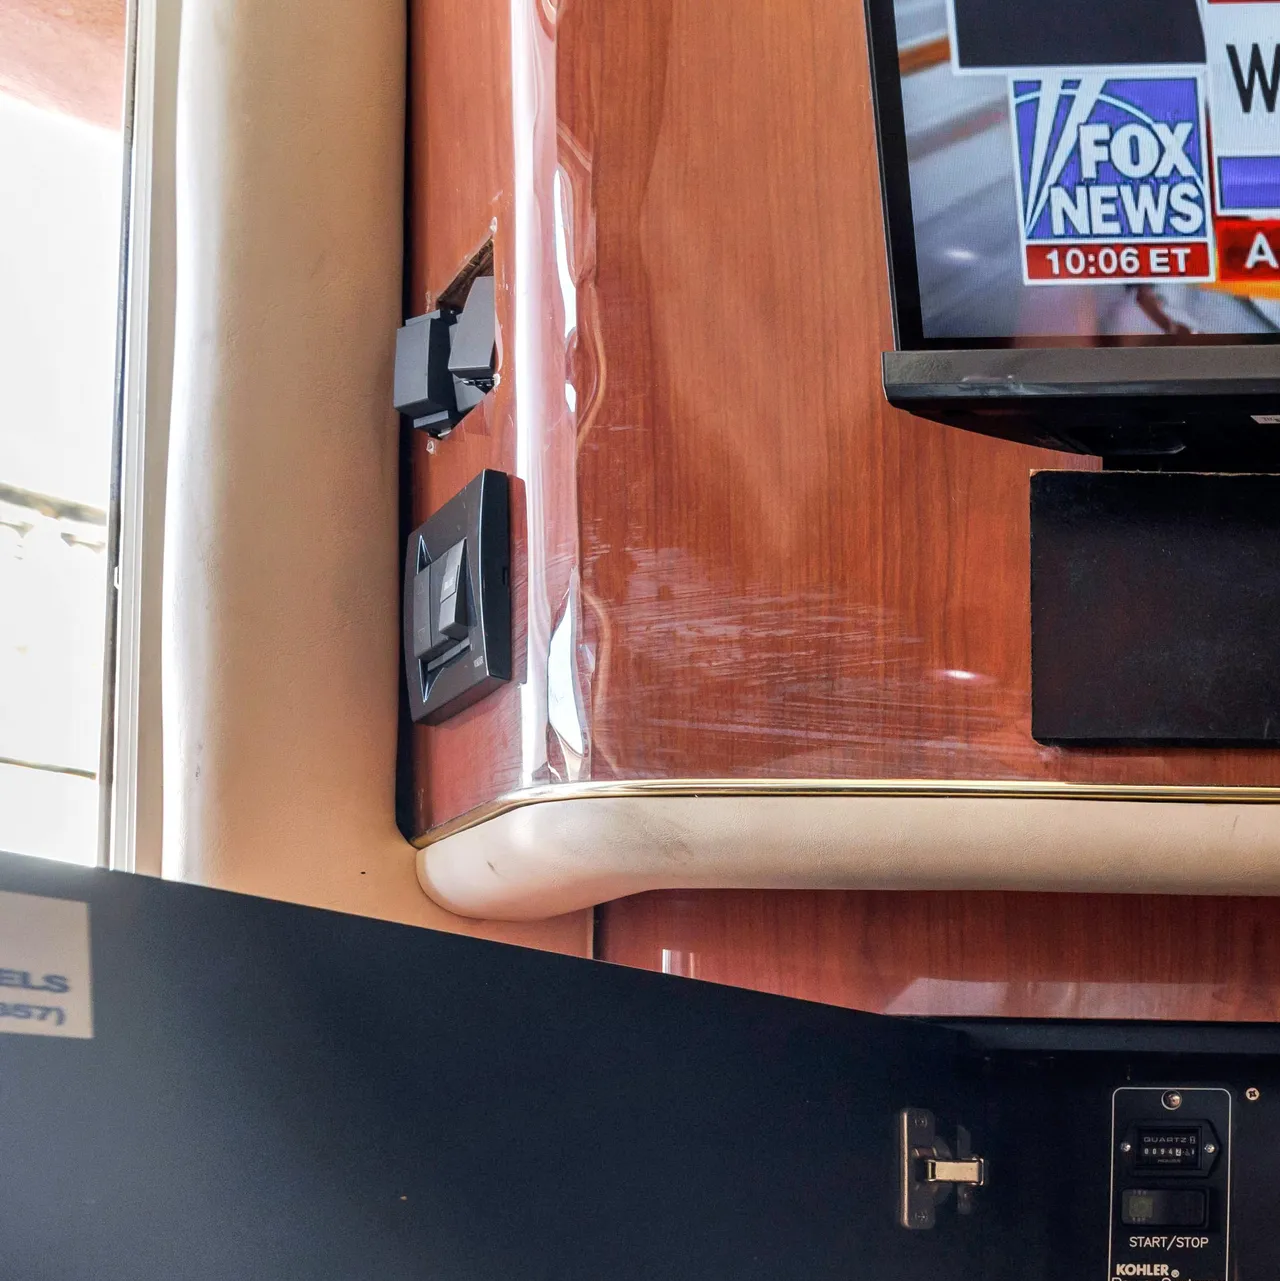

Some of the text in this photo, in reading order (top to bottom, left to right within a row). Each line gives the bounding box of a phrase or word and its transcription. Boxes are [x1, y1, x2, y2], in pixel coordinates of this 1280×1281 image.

[1078, 121, 1194, 181] FOX
[1050, 182, 1206, 238] NEWS
[1045, 247, 1192, 276] 10:06 ET
[1130, 1236, 1208, 1250] START/STOP
[1116, 1264, 1169, 1276] KOHLER
